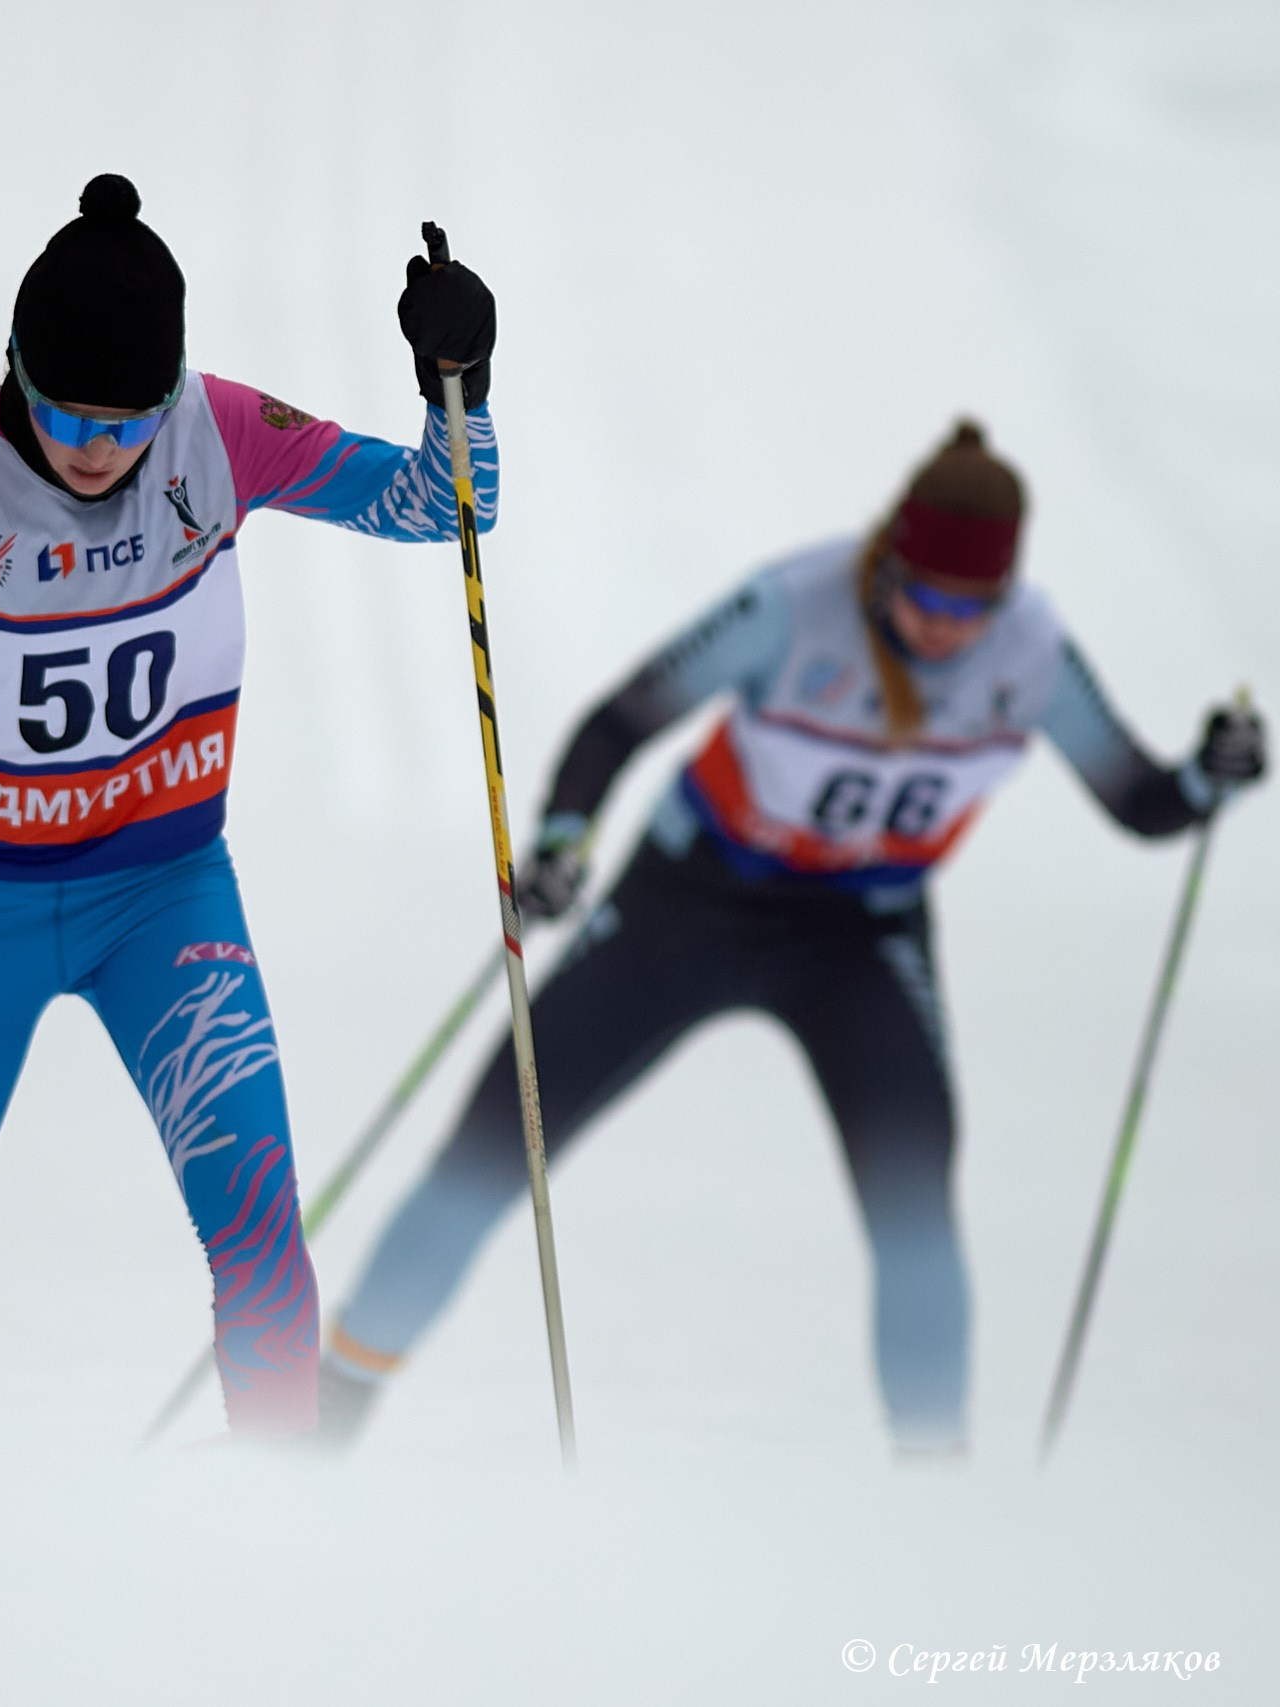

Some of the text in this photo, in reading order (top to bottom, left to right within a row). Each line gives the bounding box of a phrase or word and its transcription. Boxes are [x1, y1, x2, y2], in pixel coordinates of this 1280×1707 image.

[86, 533, 145, 573] ПСБ
[19, 630, 176, 753] 50
[815, 769, 948, 838] 66
[177, 942, 255, 966] KV+
